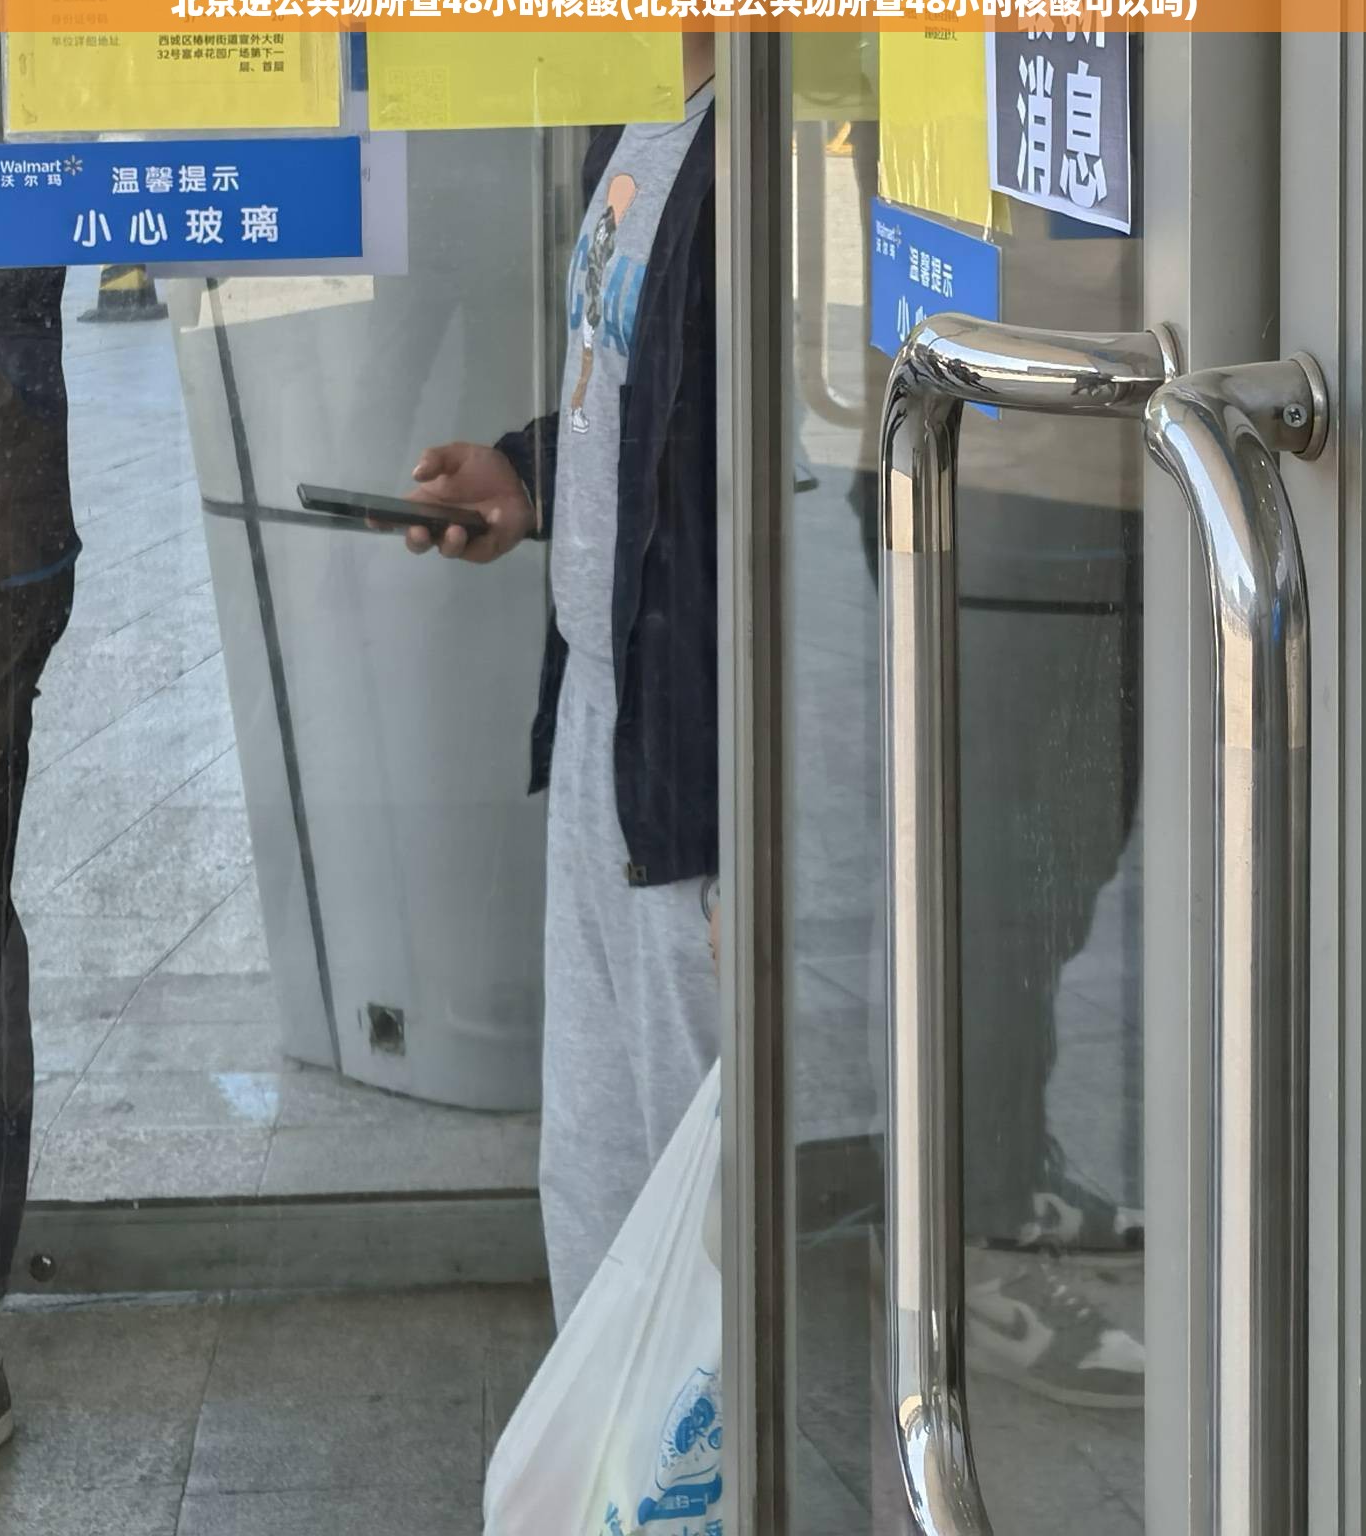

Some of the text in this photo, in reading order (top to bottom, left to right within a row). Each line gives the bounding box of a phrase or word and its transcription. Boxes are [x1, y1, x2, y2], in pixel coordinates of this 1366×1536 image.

[1016, 55, 1109, 209] 消息
[0, 159, 62, 173] Walmart
[0, 174, 63, 188] 沃尔玛
[111, 165, 240, 195] 温馨提示
[72, 203, 280, 248] 小心玻璃
